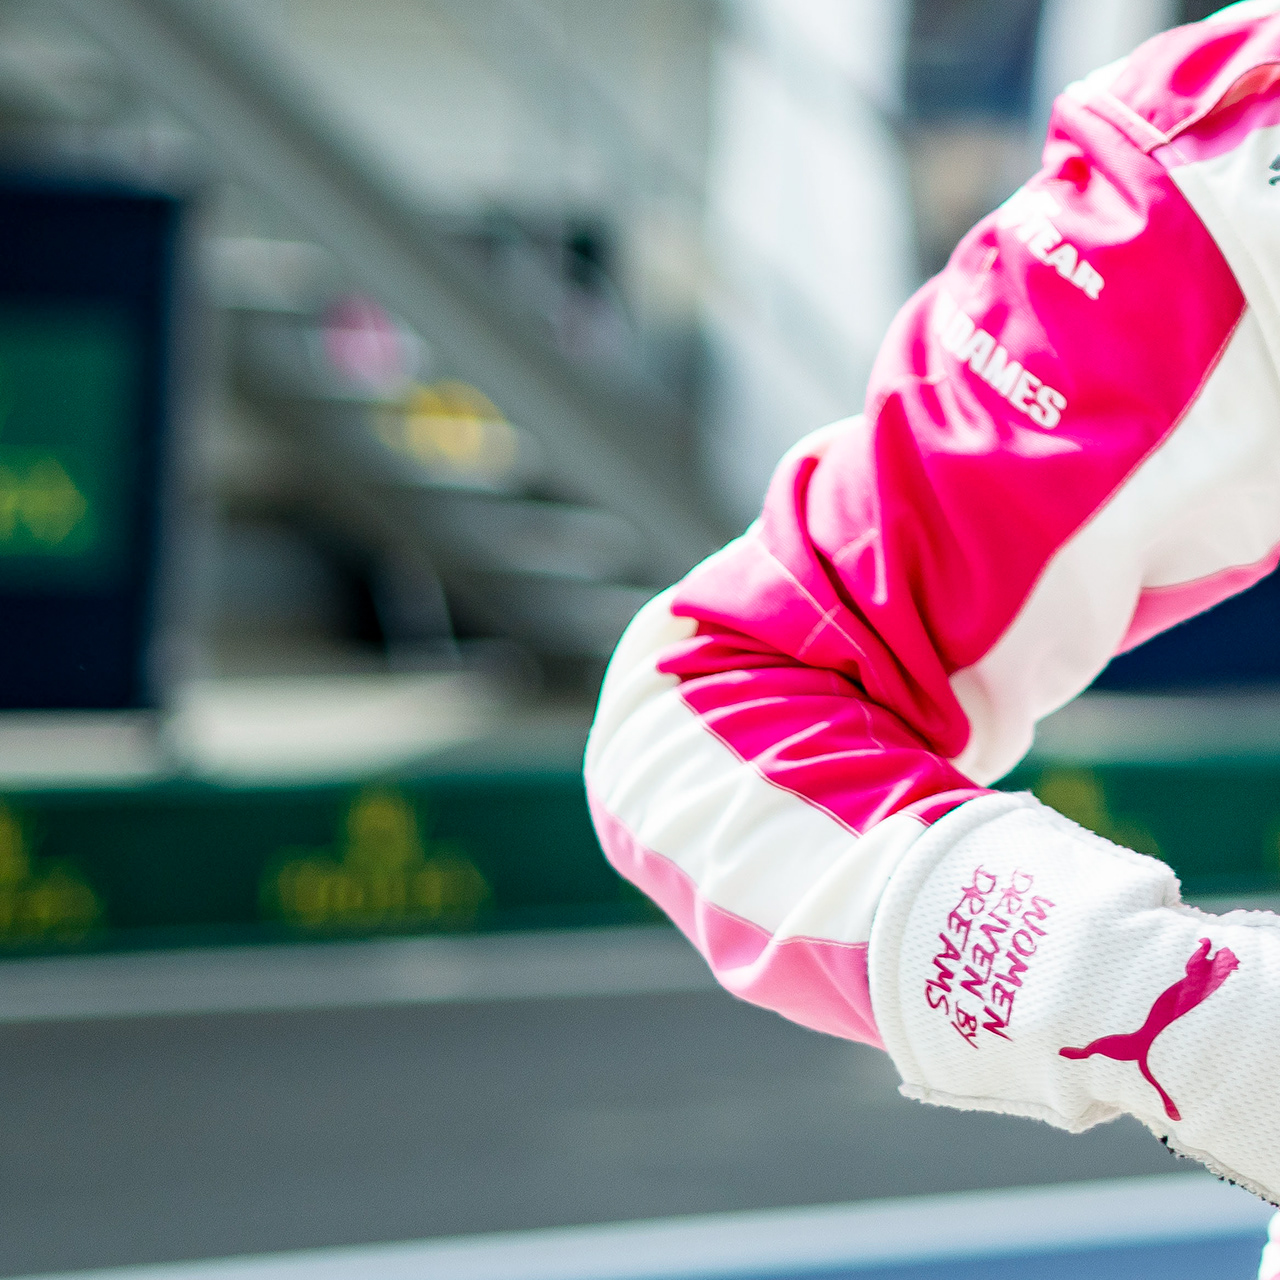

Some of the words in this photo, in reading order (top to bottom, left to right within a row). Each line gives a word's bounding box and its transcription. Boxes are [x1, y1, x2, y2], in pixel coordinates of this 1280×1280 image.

[925, 864, 997, 1016] DREAMS
[959, 869, 1035, 1002] DRIVEN
[982, 895, 1056, 1042] WOMEN
[950, 1000, 980, 1050] BY
